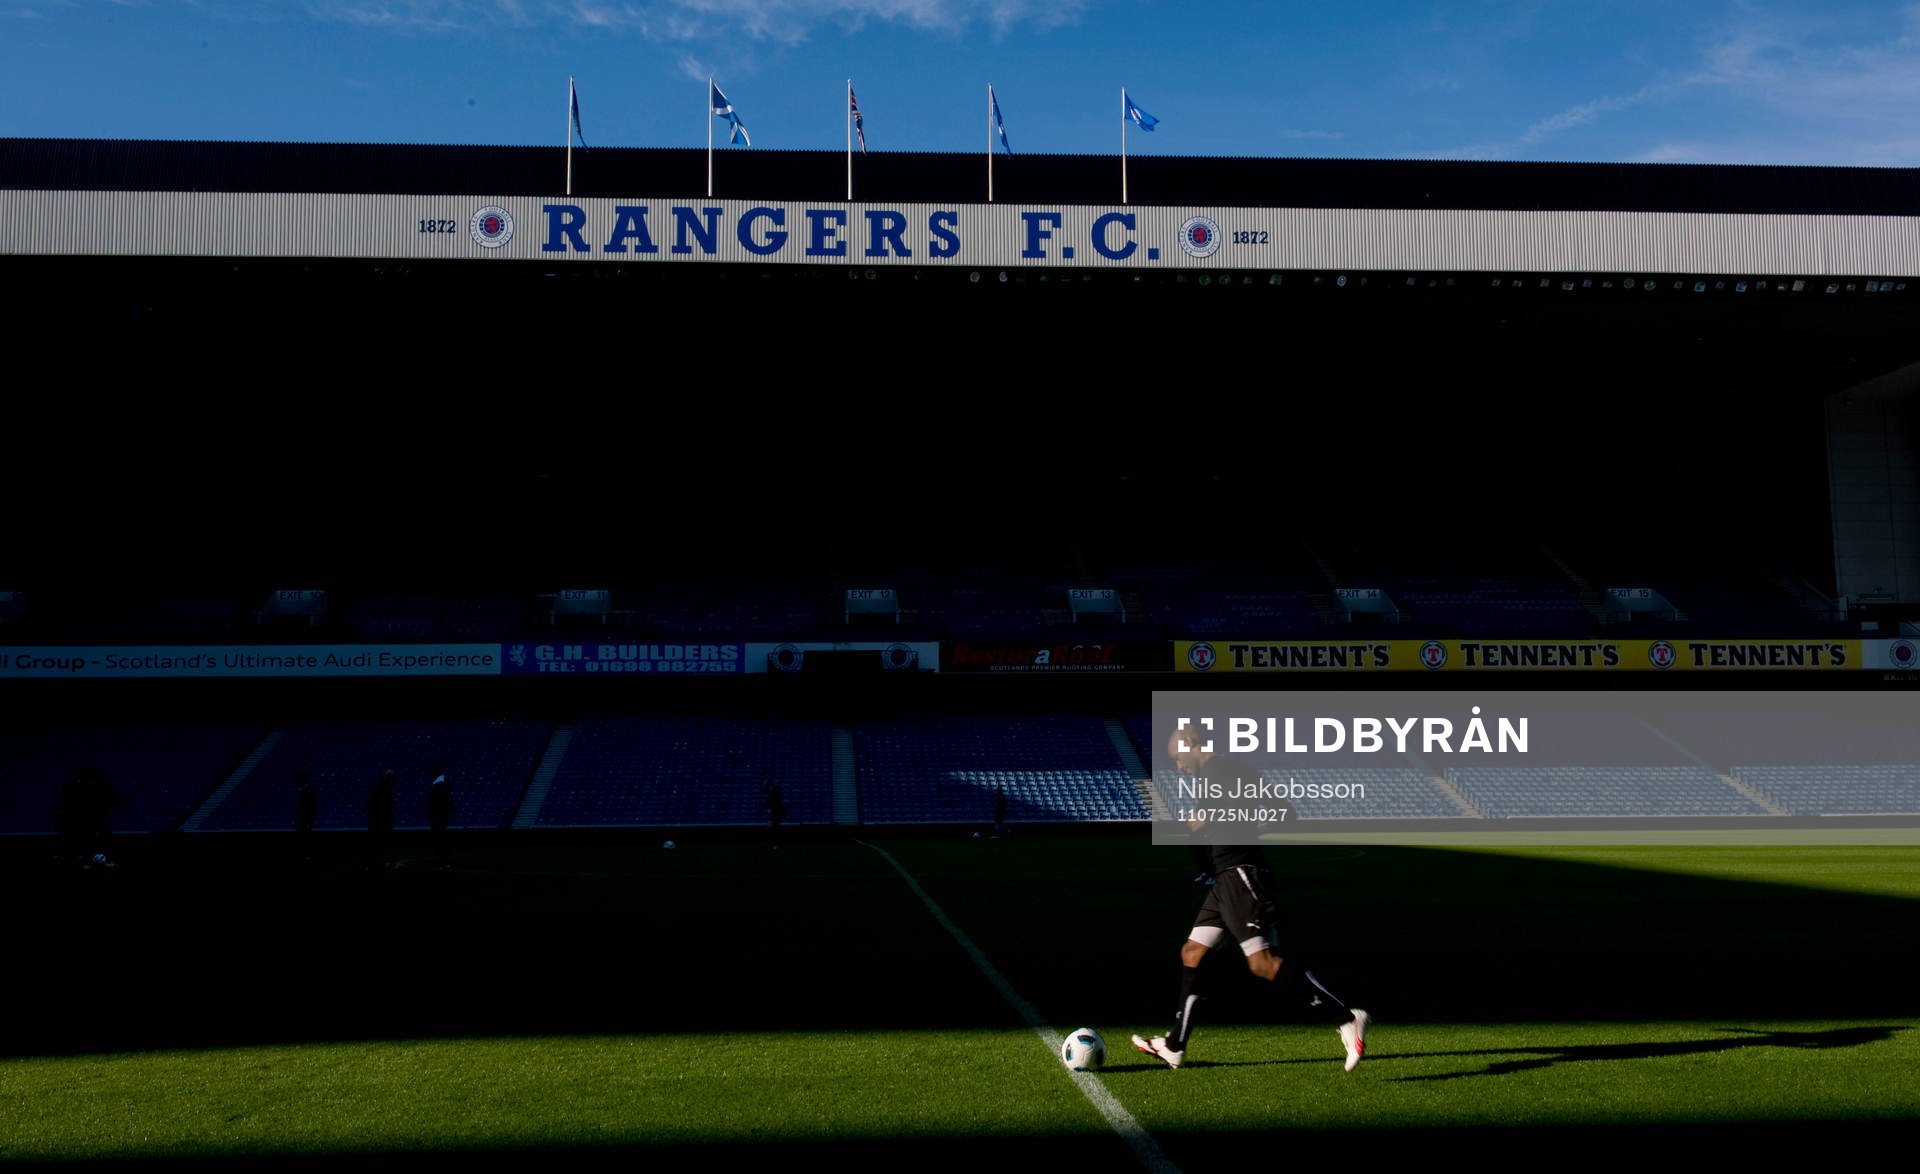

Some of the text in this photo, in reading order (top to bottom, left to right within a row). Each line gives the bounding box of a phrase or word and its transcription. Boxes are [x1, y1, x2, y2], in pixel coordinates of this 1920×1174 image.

[418, 219, 456, 234] 1872
[542, 204, 960, 257] RANGERS
[1021, 211, 1160, 261] F.C.
[1232, 231, 1269, 245] 1872
[564, 591, 586, 600] EXIT
[851, 590, 873, 599] EXIT
[1072, 591, 1094, 600] EXIT
[1338, 590, 1360, 599] EXIT
[535, 645, 739, 661] G.H. BUILDERS
[1229, 644, 1390, 668] TENNENT'S
[1460, 643, 1619, 667] TENNENT'S
[1689, 643, 1846, 667] TENNENT'S
[15, 655, 86, 672] Group
[105, 653, 217, 670] Scotland's
[224, 653, 318, 670] Ultimate
[323, 652, 372, 669] Audi
[379, 652, 494, 672] Experience
[536, 661, 576, 673] TEL:
